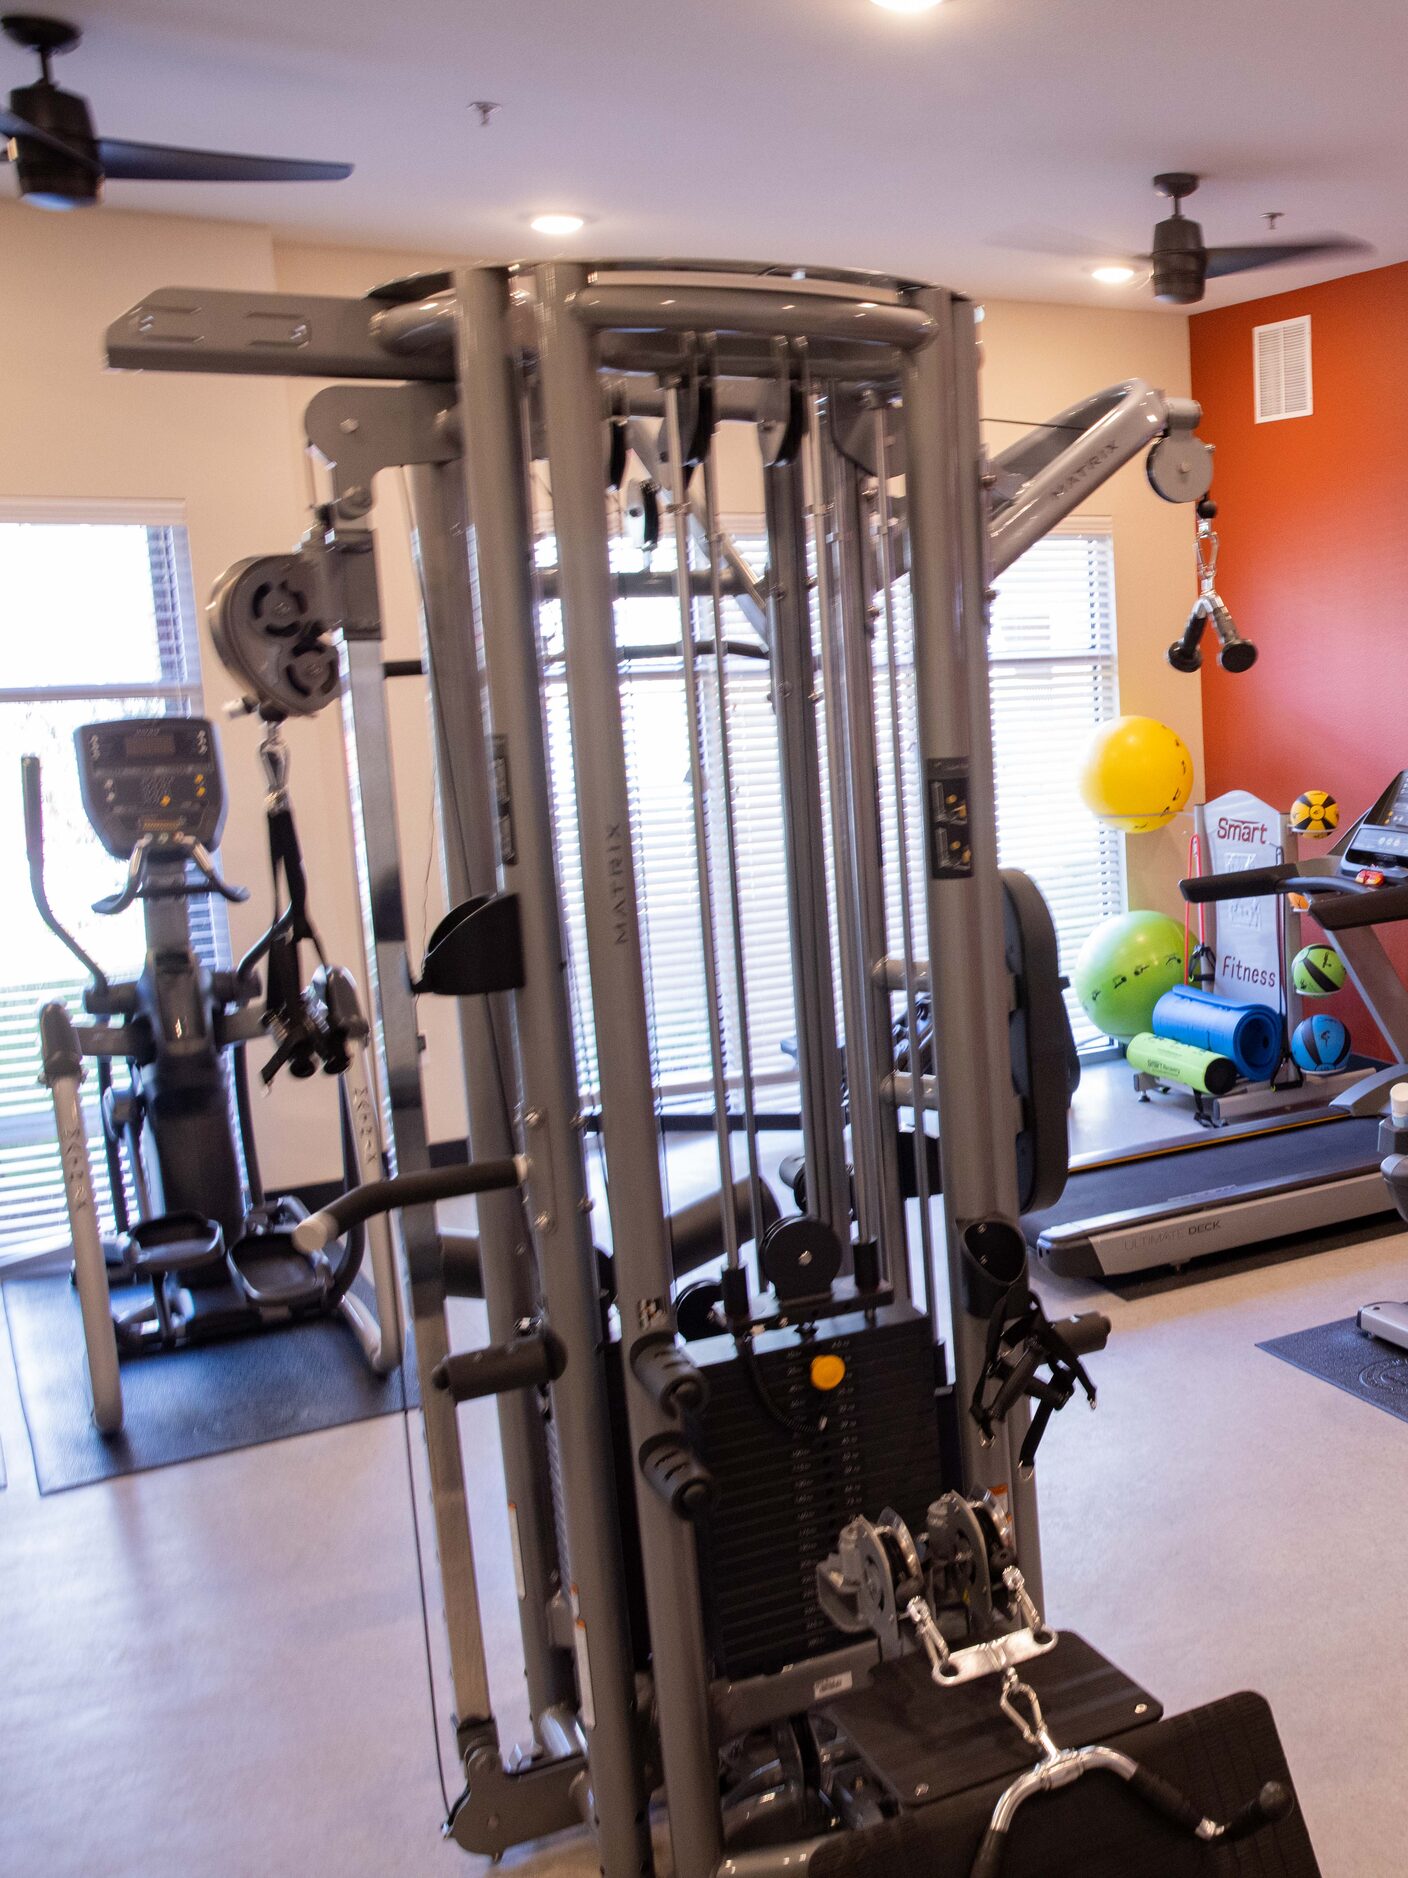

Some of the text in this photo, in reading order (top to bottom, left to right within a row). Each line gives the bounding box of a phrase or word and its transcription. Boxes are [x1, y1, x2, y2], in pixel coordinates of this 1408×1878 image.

[1217, 817, 1268, 844] Smart
[604, 824, 629, 946] MATRIX
[1222, 955, 1276, 988] Fitness
[1187, 1219, 1221, 1236] DECK
